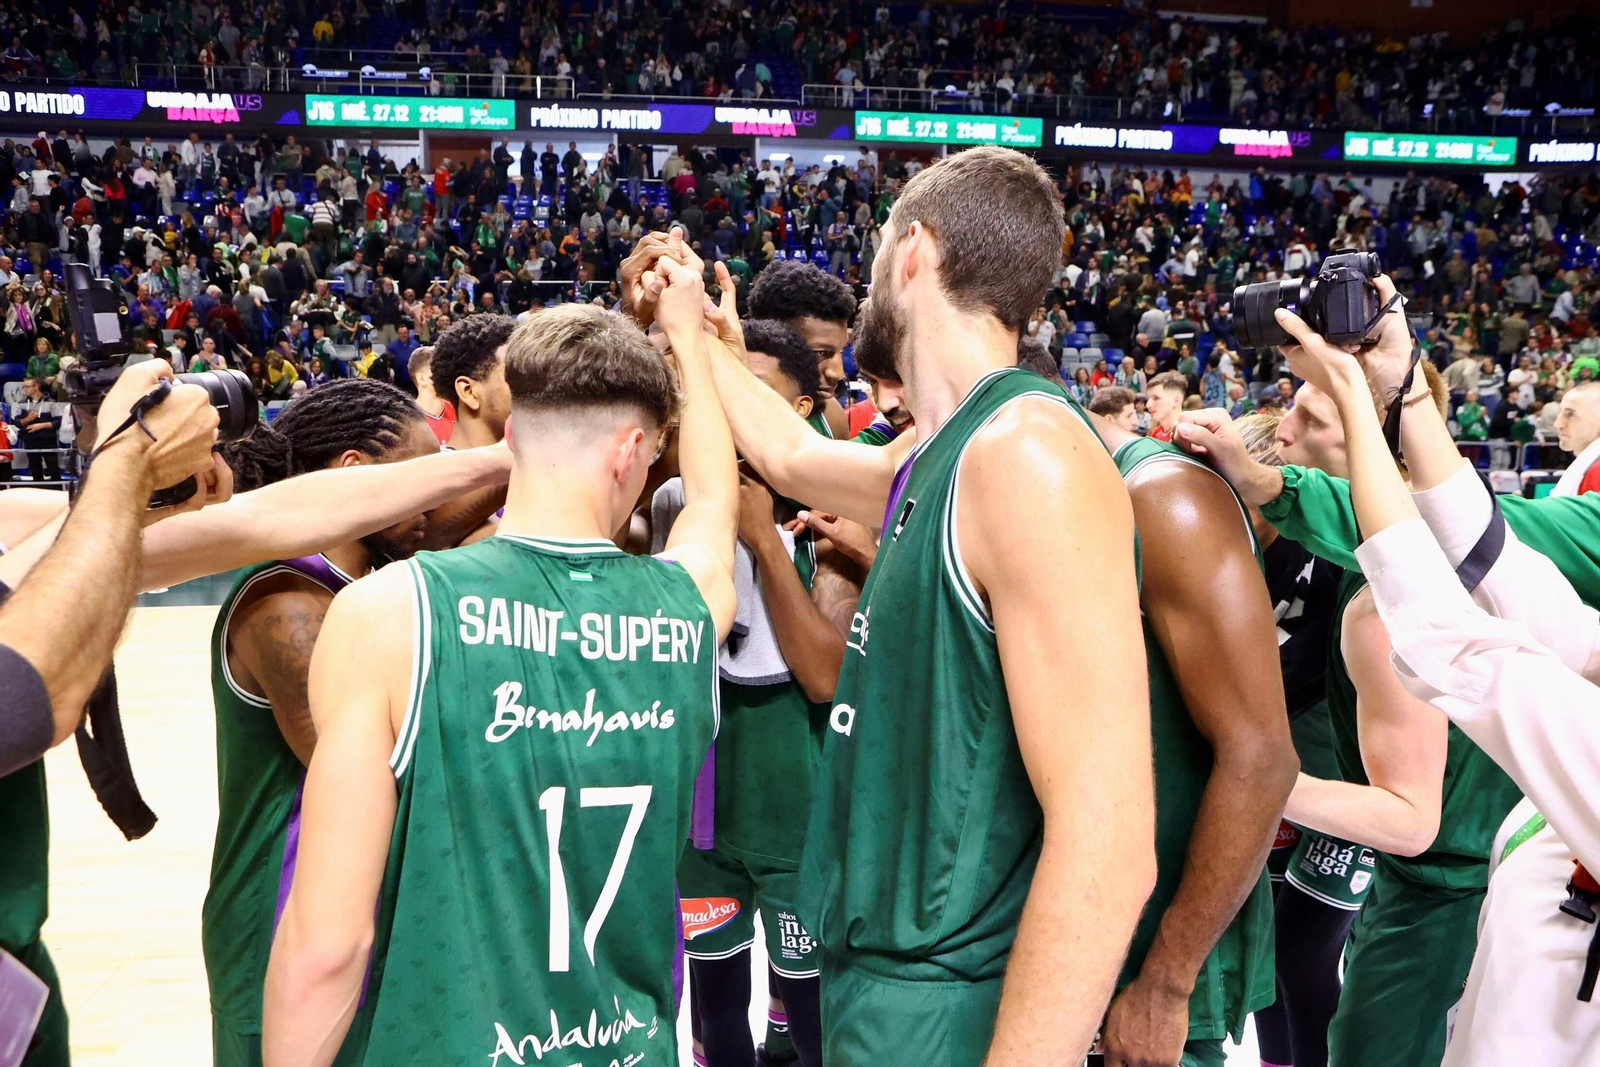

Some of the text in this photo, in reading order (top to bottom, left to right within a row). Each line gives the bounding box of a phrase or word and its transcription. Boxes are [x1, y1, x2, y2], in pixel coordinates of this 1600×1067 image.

[15, 92, 85, 115] PARTIDO
[234, 94, 262, 111] VS
[308, 101, 335, 121] J16
[341, 100, 370, 121] MIÉ.
[373, 104, 409, 122] 27.12
[530, 104, 662, 130] PRÓXIMO PARTIDO
[857, 117, 881, 136] J16
[915, 120, 948, 138] 27.12
[1055, 123, 1173, 150] PRÓXIMO PARTIDO
[1529, 139, 1595, 163] PRÓXIMO
[458, 595, 704, 664] SAINT-SUPÉRY
[538, 785, 653, 972] 17
[682, 901, 737, 923] madesa
